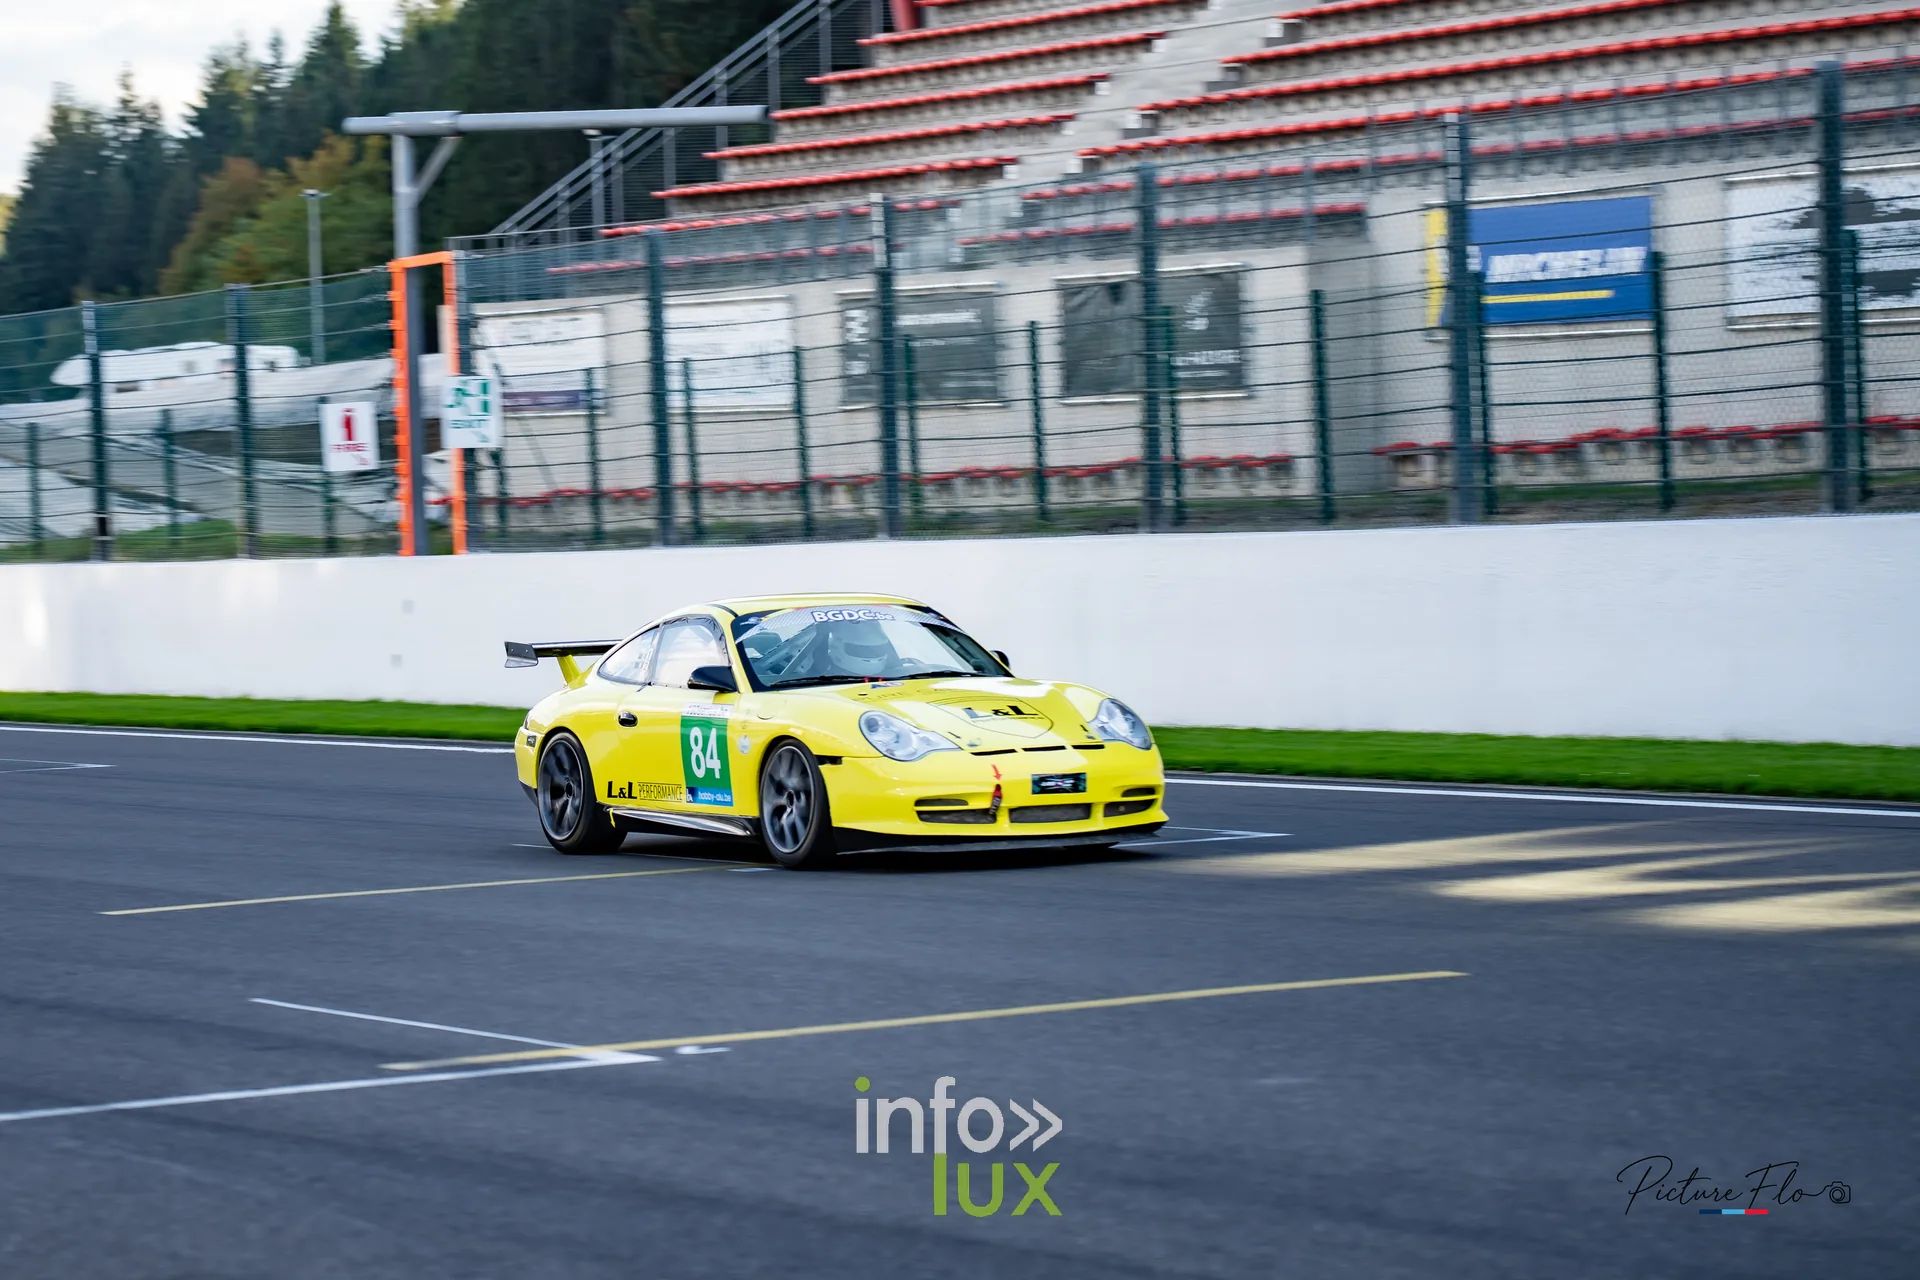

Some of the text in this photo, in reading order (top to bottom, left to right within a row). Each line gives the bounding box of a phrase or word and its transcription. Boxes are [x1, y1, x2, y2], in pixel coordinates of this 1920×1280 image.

[1485, 246, 1648, 283] MICHELIN
[811, 608, 896, 623] BGDC.be
[962, 704, 1040, 720] L&L
[690, 727, 721, 778] 84
[607, 781, 638, 799] L&L
[638, 784, 682, 801] PERFORMANCE
